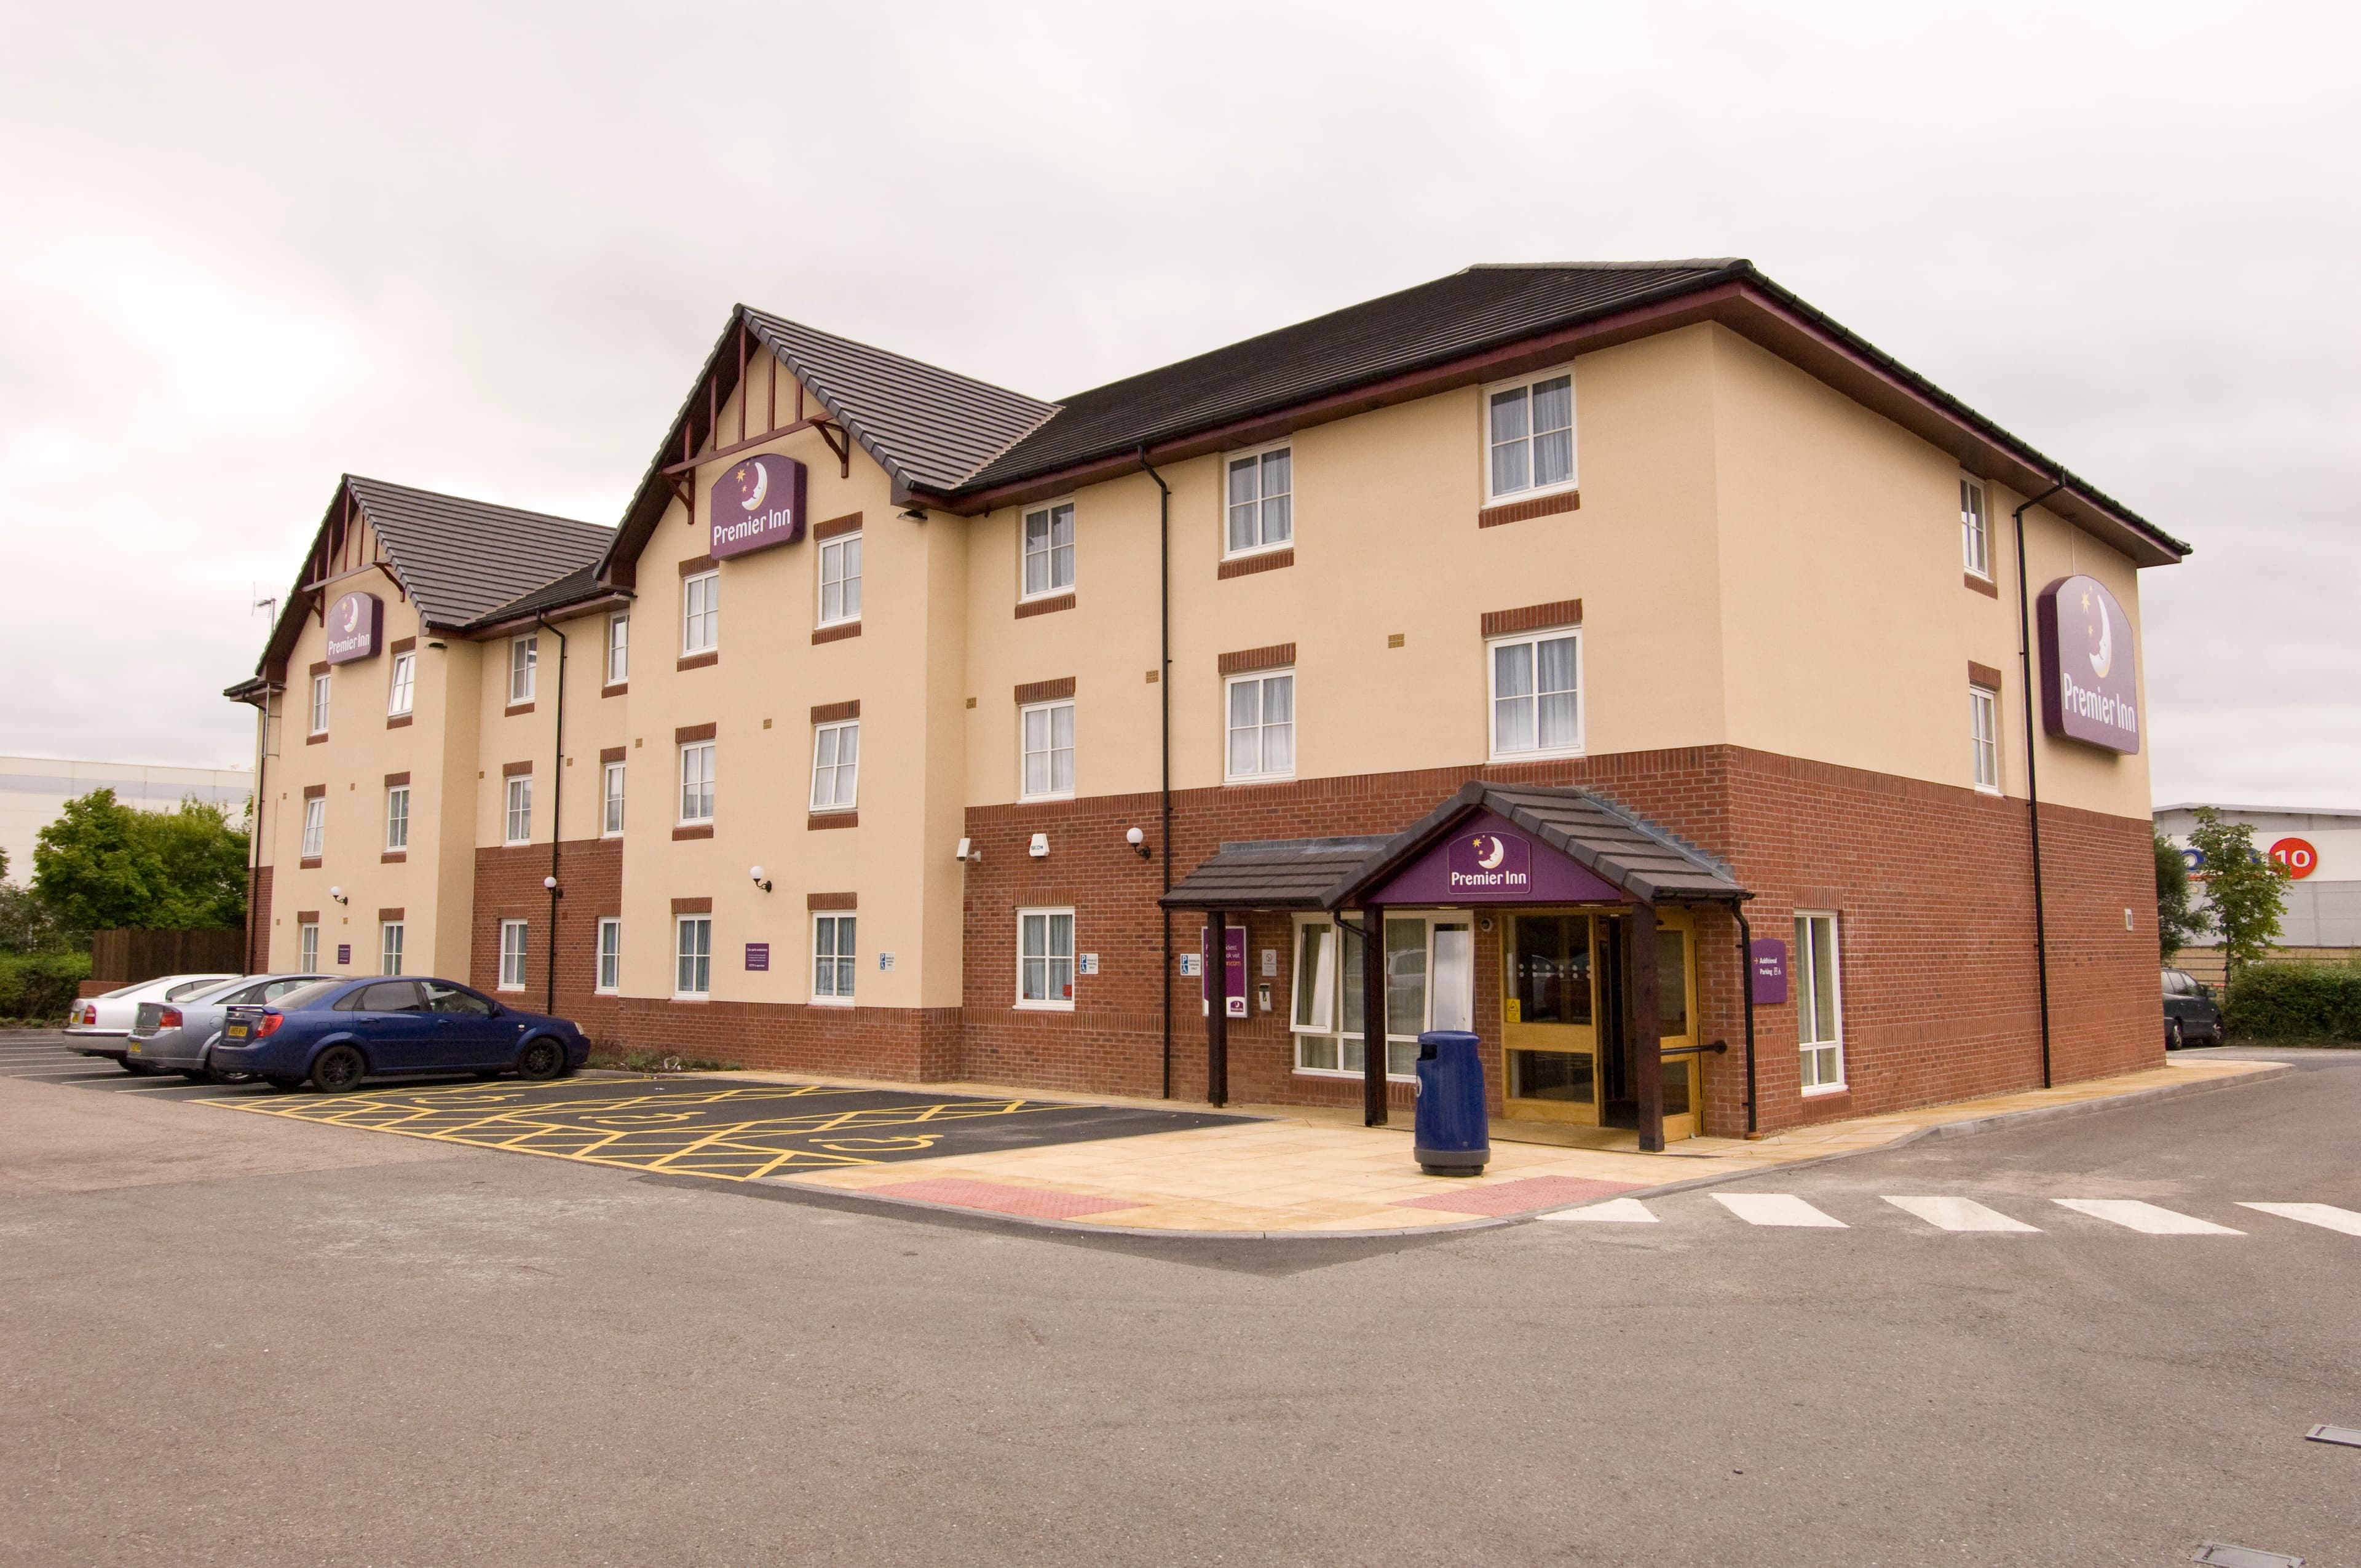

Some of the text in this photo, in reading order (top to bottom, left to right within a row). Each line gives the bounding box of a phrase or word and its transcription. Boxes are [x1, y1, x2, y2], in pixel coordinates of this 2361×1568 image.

[713, 509, 791, 546] Premier Inn
[328, 633, 370, 655] Premier Inn
[2063, 673, 2136, 733] Premier Inn
[2275, 850, 2311, 868] 10
[1451, 870, 1527, 885] Premier Inn
[1760, 968, 1773, 976] Parking
